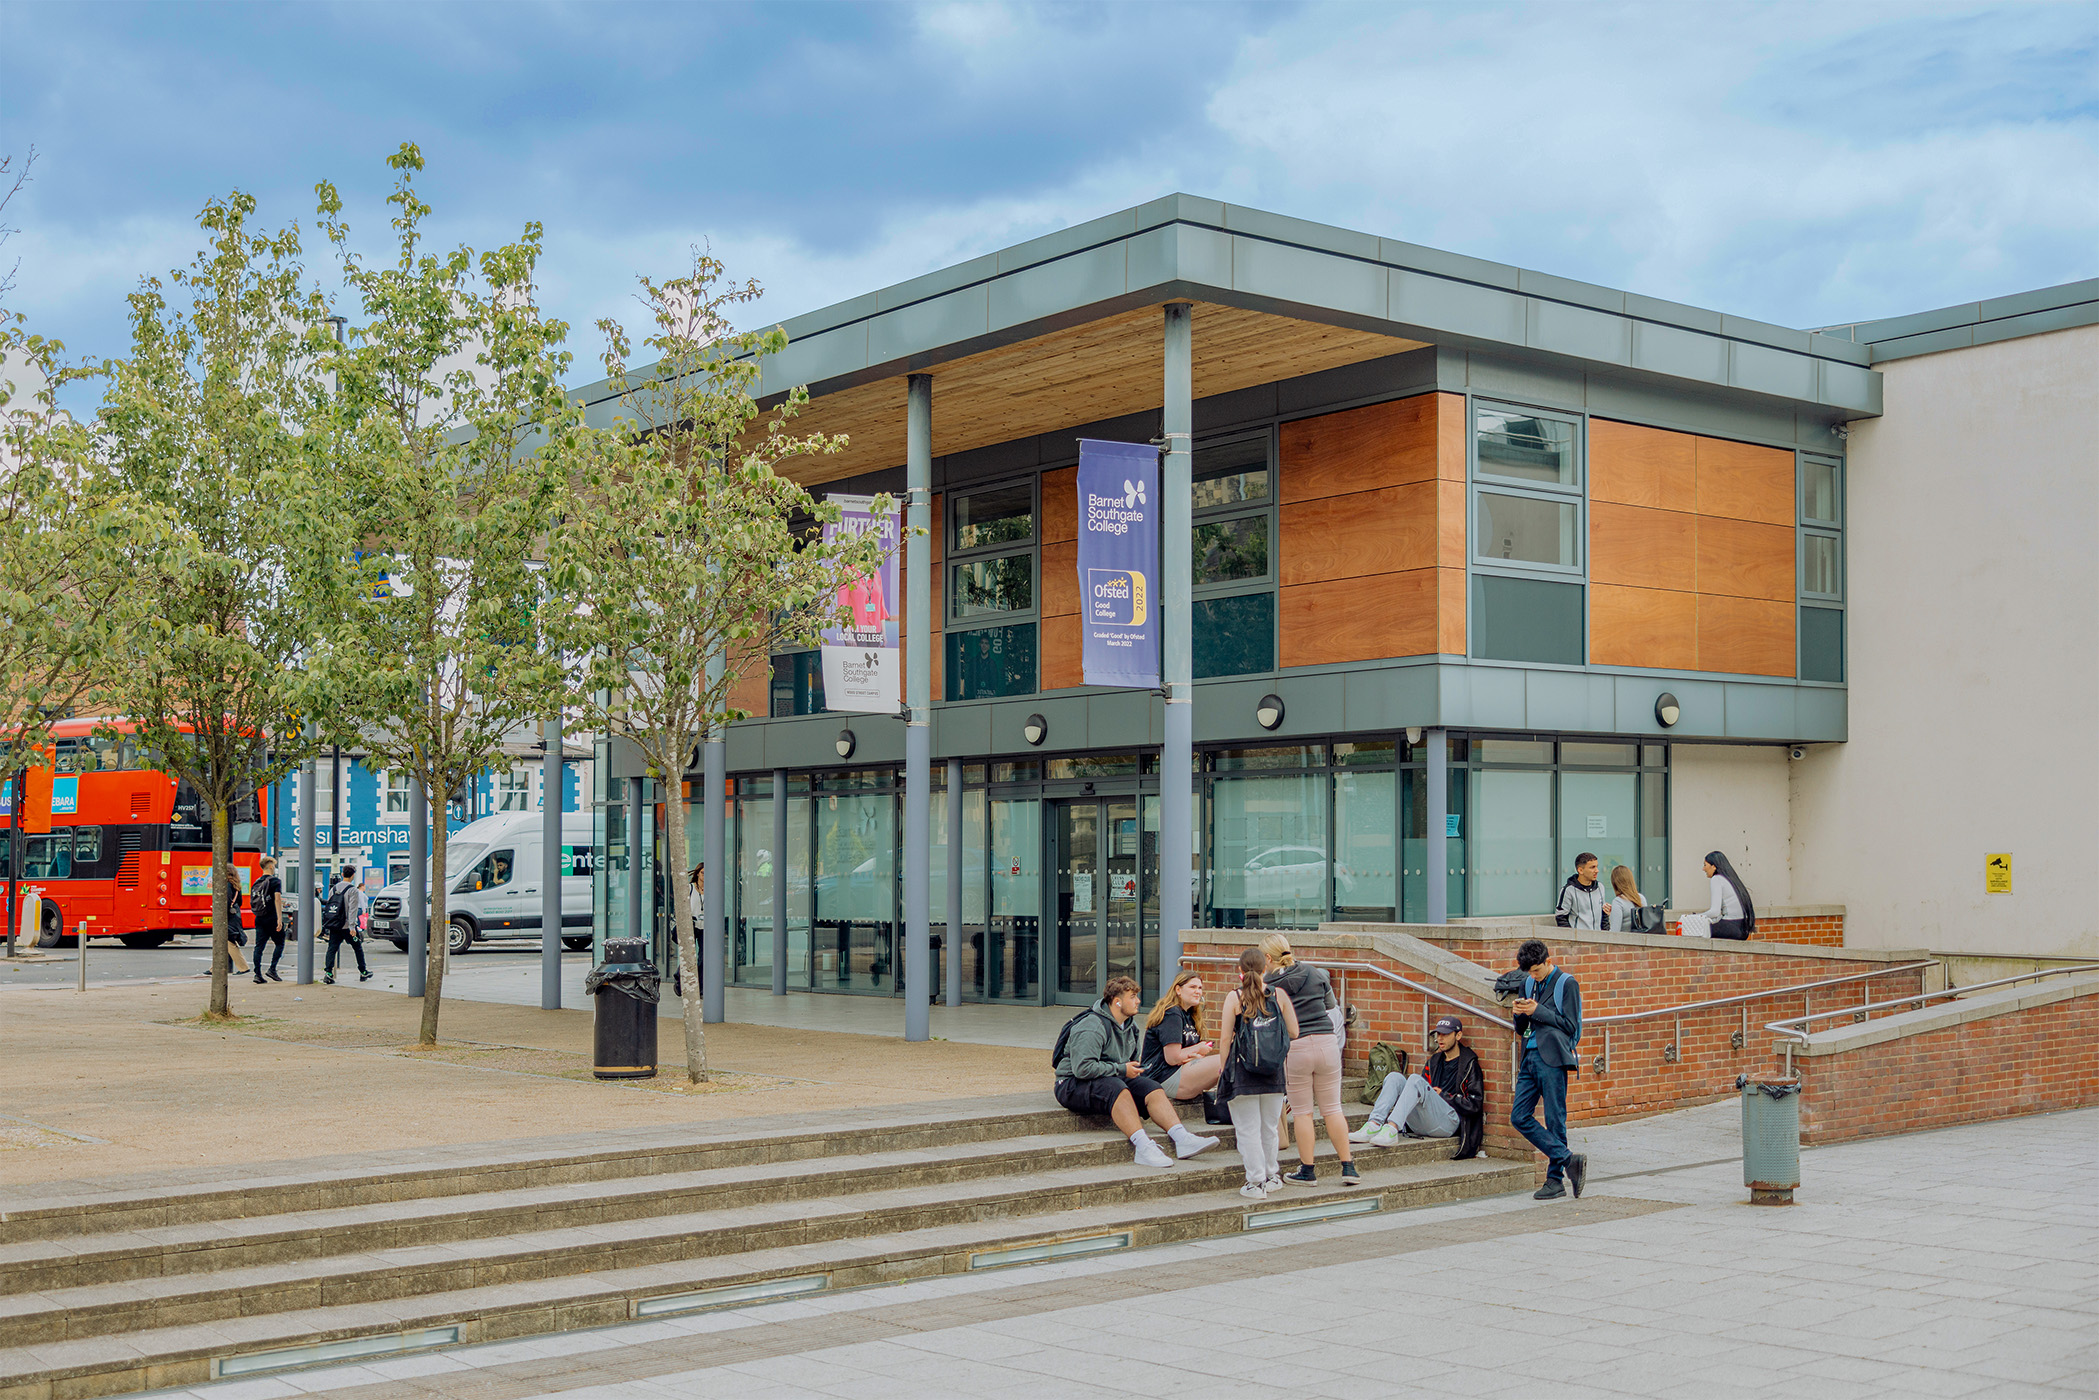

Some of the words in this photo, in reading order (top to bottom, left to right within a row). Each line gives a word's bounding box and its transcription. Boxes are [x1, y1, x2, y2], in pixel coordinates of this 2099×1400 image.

[1088, 493, 1125, 509] Barnet
[1087, 506, 1144, 523] Southgate
[1087, 519, 1129, 536] College
[1094, 584, 1129, 599] Ofsted
[1135, 585, 1144, 612] 2022
[1094, 601, 1111, 609] Good
[1094, 609, 1116, 618] College
[860, 625, 877, 633] YOUR
[836, 632, 856, 642] LOCAL
[857, 634, 884, 642] COLLEGE
[842, 660, 866, 669] Barnet
[842, 668, 878, 677] Southgate
[843, 676, 869, 684] College
[52, 796, 74, 806] EBARA
[292, 827, 330, 844] Ssi
